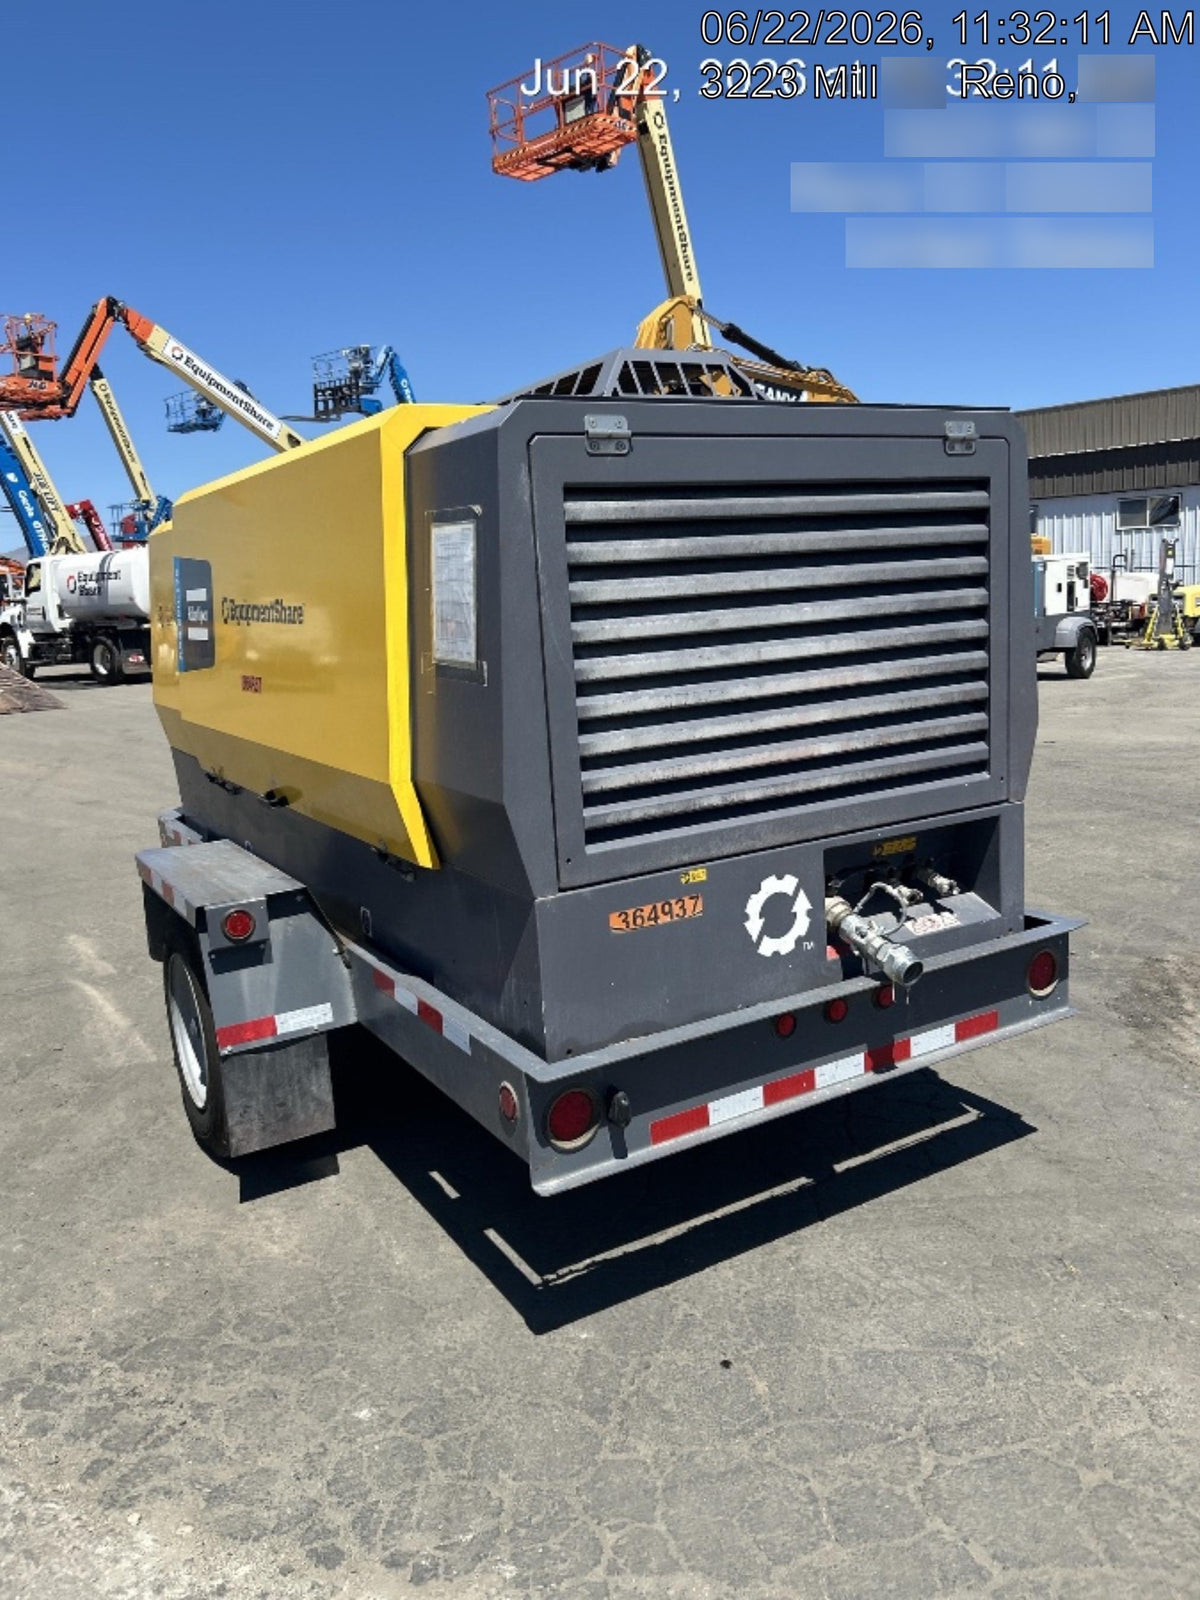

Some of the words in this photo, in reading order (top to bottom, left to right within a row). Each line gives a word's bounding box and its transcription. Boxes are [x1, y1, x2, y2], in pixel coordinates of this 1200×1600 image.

[658, 133, 694, 283] EquipmentShare
[184, 354, 275, 432] EquipmentShare
[229, 598, 304, 627] EquipmentShare
[615, 894, 701, 931] 364937
